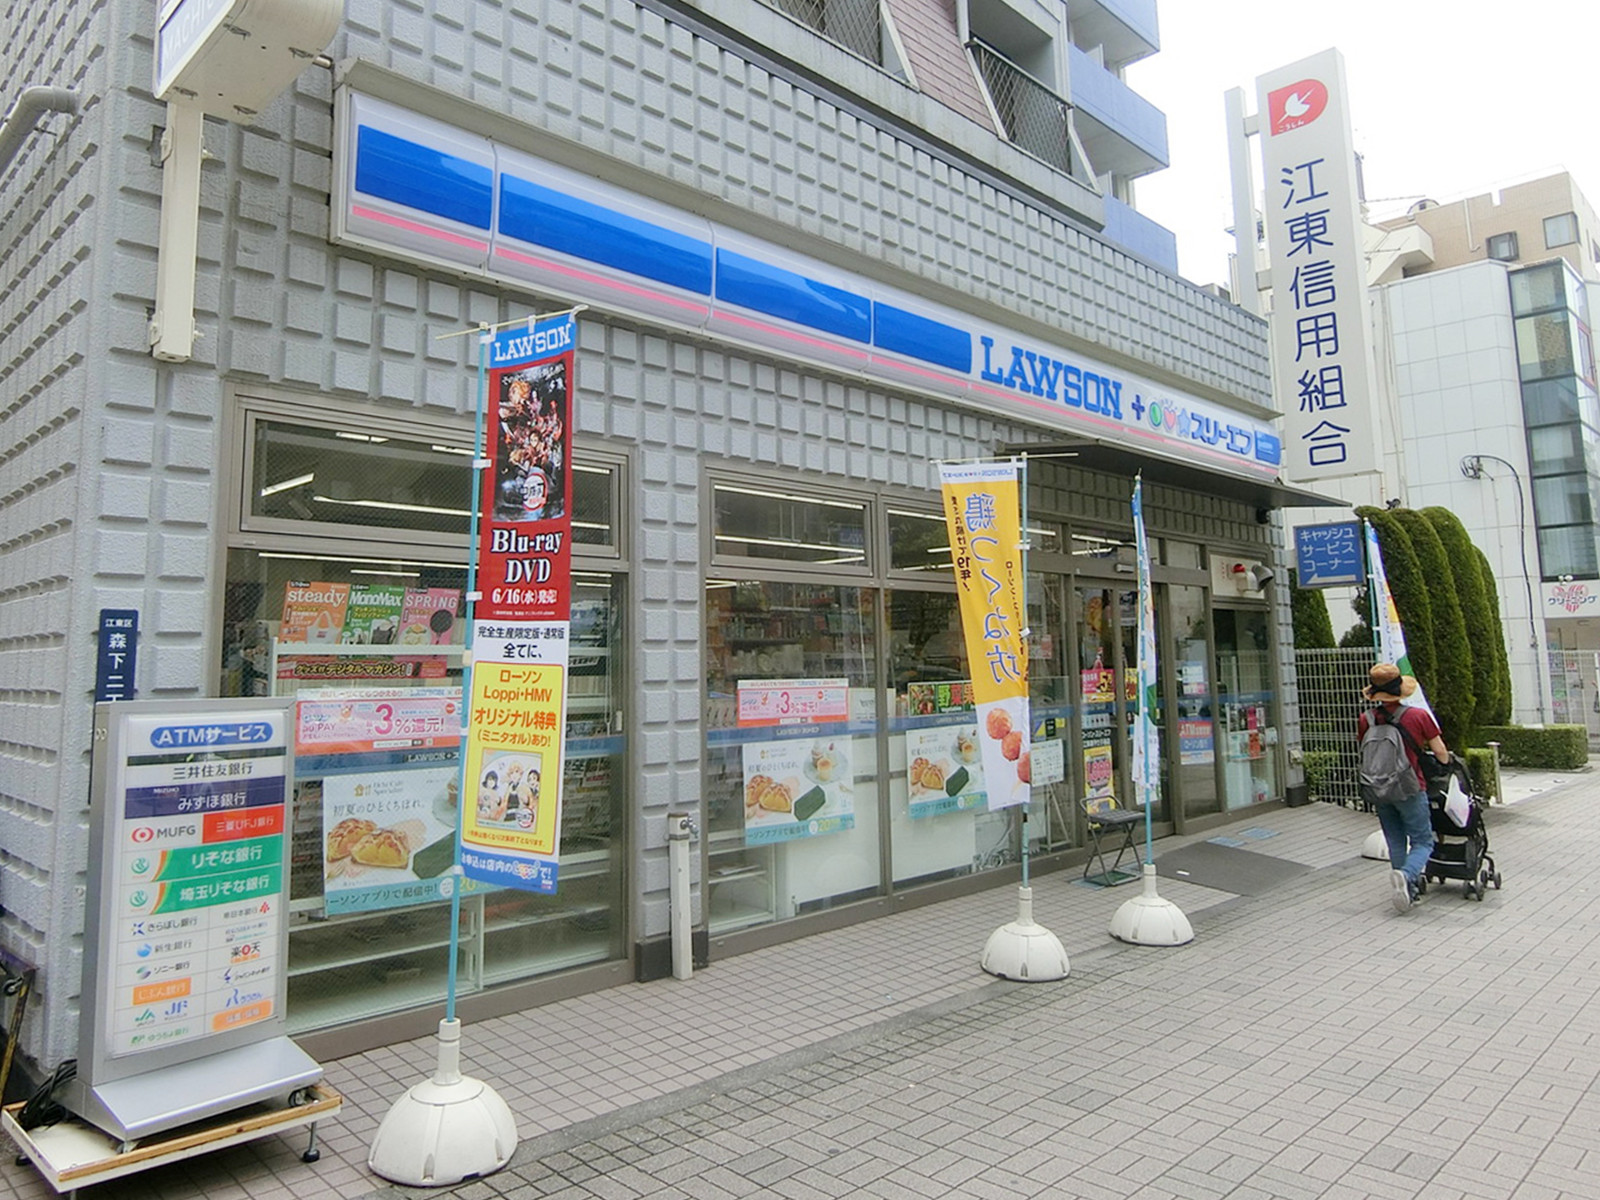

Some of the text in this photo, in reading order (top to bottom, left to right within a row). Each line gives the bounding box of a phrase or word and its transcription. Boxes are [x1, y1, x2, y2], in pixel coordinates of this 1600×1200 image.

[1281, 158, 1351, 467] 江東信用組合
[494, 323, 572, 362] LAWSON
[980, 335, 1124, 421] LAWSON
[1190, 412, 1254, 455] スリーエフ
[491, 528, 563, 554] Blu-ray
[1300, 526, 1355, 542] キャッシュ
[1301, 540, 1355, 558] サービス
[505, 558, 551, 584] DVD
[1303, 557, 1356, 573] コーナー
[349, 591, 402, 607] MonoMax
[1548, 595, 1598, 606] クリーニング
[502, 641, 543, 658] 全てに、
[499, 669, 542, 684] ローソン
[317, 722, 336, 732] PAY
[473, 707, 557, 731] オリジナル特典
[157, 725, 267, 745] ATMサービス
[172, 761, 253, 780] 三井住友銀行
[177, 791, 247, 811] みずほ銀行
[156, 825, 196, 839] MUFG
[216, 815, 275, 832] 三菱UFJ銀行
[191, 845, 263, 869] りそな銀行
[179, 874, 270, 902] 埼玉りそな銀行
[154, 939, 192, 953] 新生銀行
[154, 961, 190, 975] ソニー銀行
